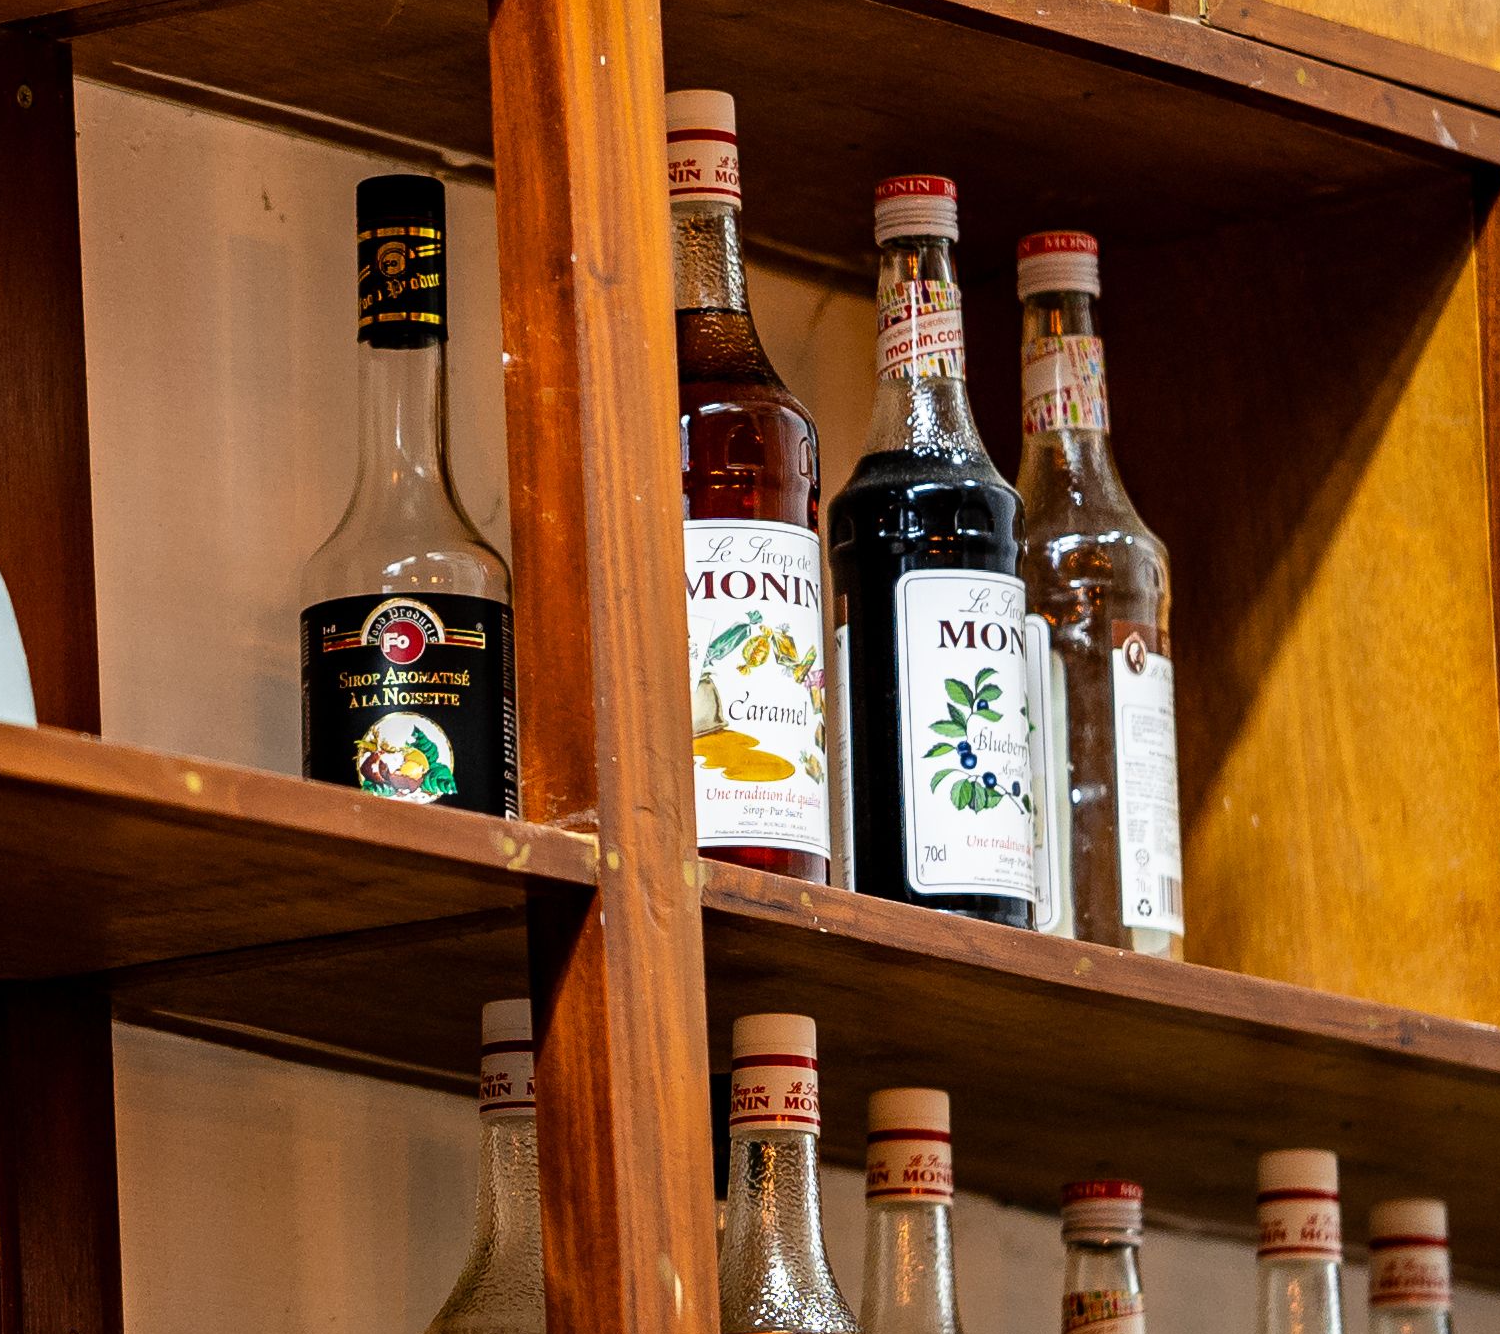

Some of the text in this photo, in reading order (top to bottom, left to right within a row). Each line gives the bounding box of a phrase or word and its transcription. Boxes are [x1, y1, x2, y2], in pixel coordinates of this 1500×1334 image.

[715, 170, 740, 185] MO
[696, 536, 812, 576] Le Sirop de
[685, 569, 820, 613] MONIN
[958, 588, 991, 613] Le
[340, 667, 471, 689] SIROP AROMATISÉ
[363, 696, 381, 707] LA
[383, 687, 461, 707] NOISETTE
[729, 691, 808, 727] Caramel
[706, 788, 732, 801] Une
[734, 786, 783, 803] tradition
[785, 788, 795, 804] de
[966, 835, 988, 847] Une
[924, 844, 947, 863] 70cl
